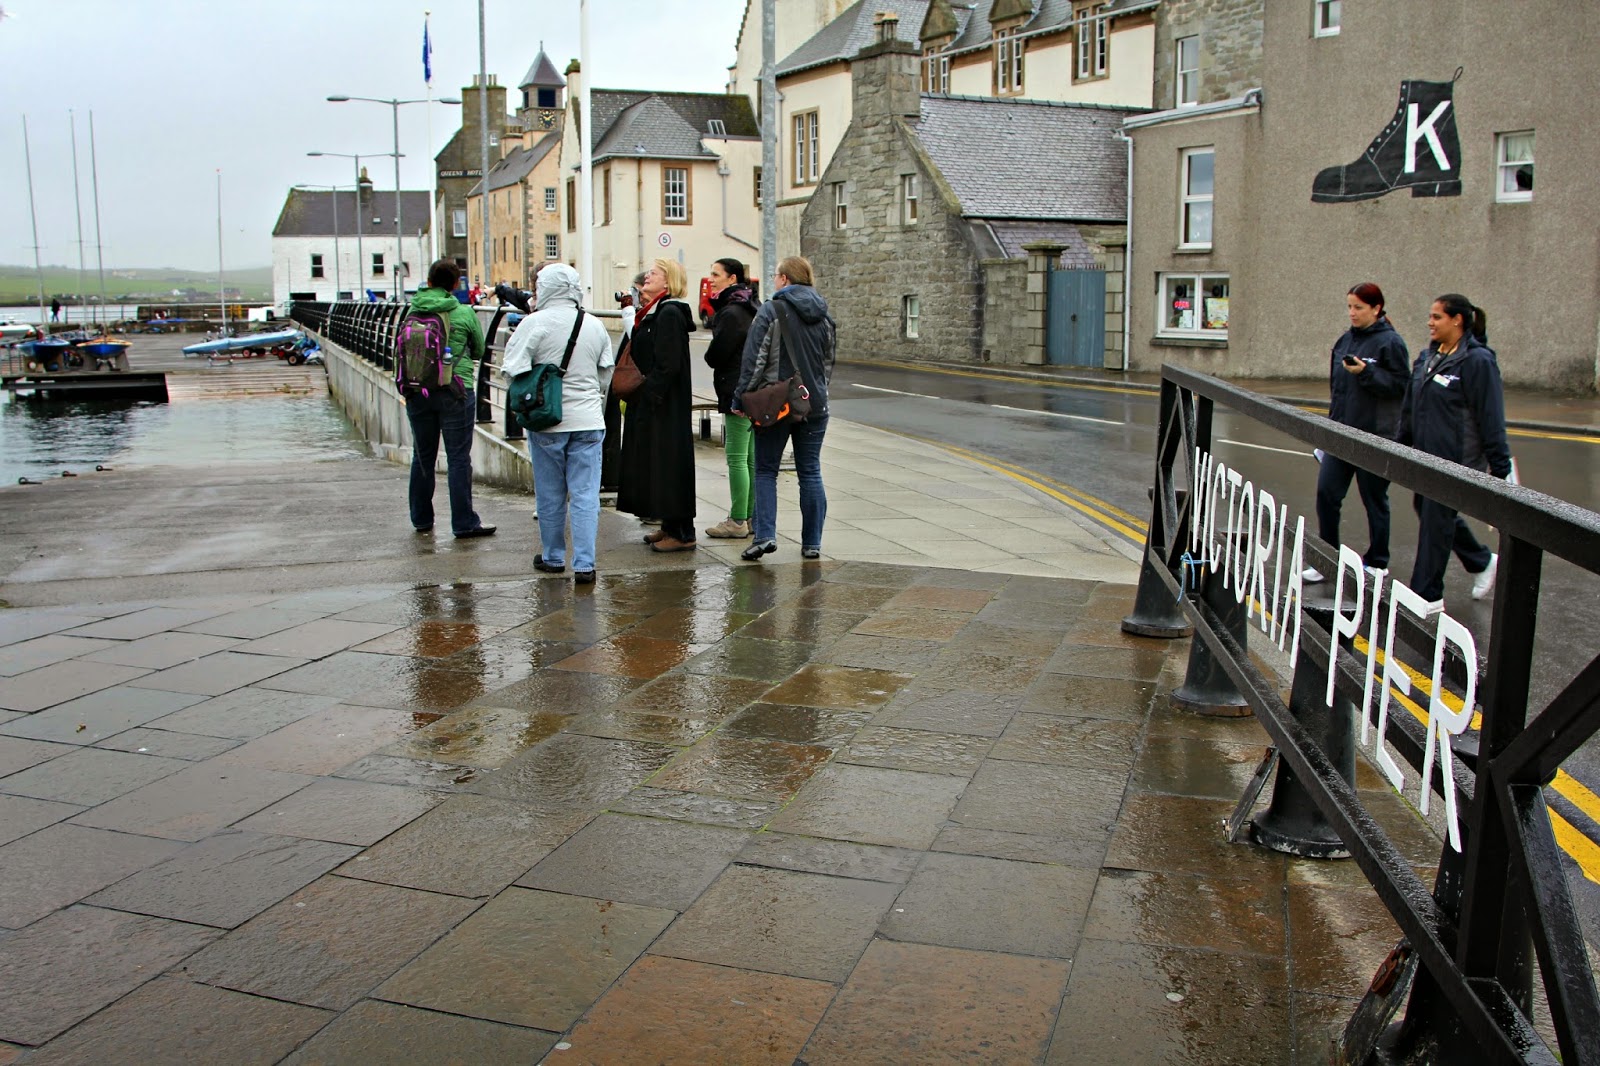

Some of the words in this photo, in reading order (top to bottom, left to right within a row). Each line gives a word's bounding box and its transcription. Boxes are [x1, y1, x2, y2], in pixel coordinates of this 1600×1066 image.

[1404, 100, 1451, 173] K
[662, 236, 668, 244] 5
[1192, 446, 1305, 668] VICTORIA
[1326, 544, 1478, 853] PIER
